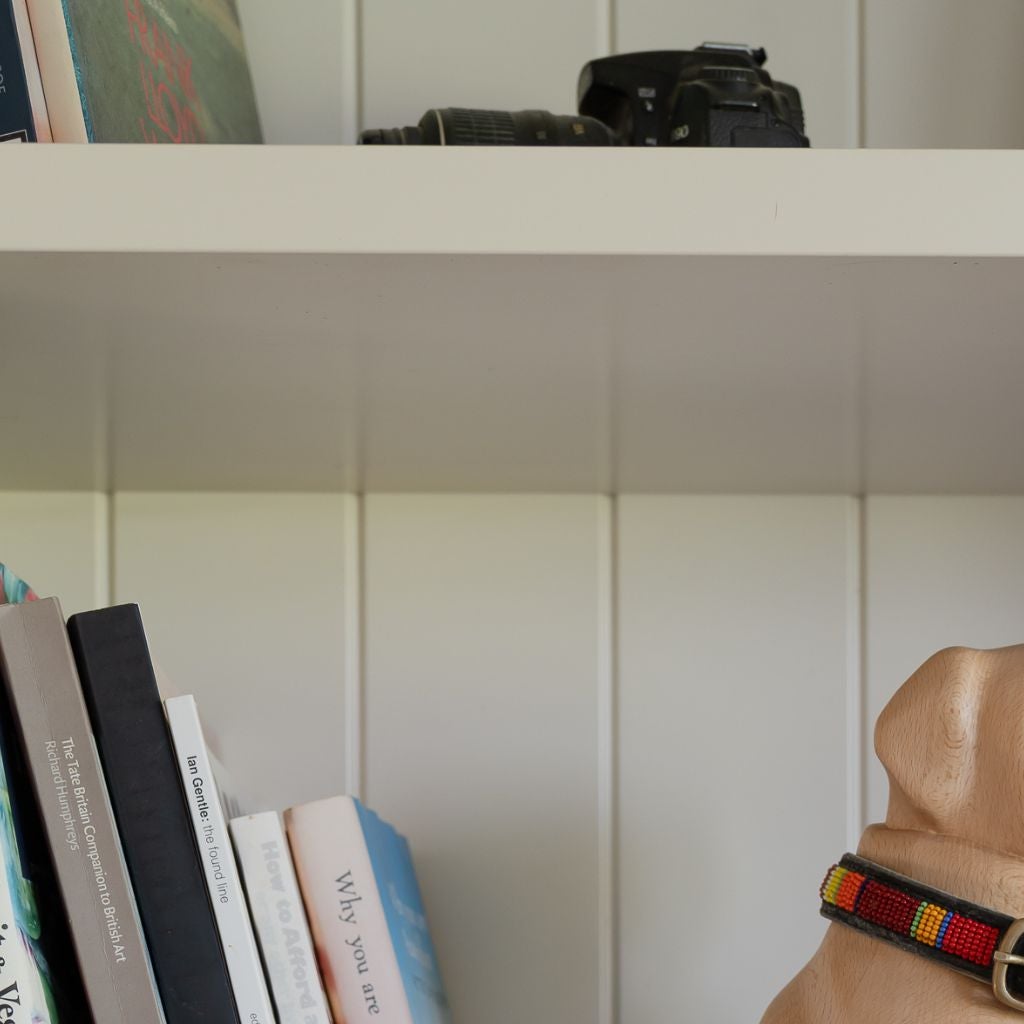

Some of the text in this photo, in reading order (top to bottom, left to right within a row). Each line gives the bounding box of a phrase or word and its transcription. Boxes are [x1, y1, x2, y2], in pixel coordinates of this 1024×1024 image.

[45, 740, 80, 851] Richard Humphreys
[61, 737, 127, 964] The Tate Britain Companion to British Art
[187, 755, 229, 904] Ian Gentle: the found line
[261, 840, 285, 892] How
[276, 899, 293, 924] to
[334, 869, 362, 925] Why
[282, 926, 318, 1010] Afford
[344, 935, 370, 975] you
[361, 983, 380, 1016] are
